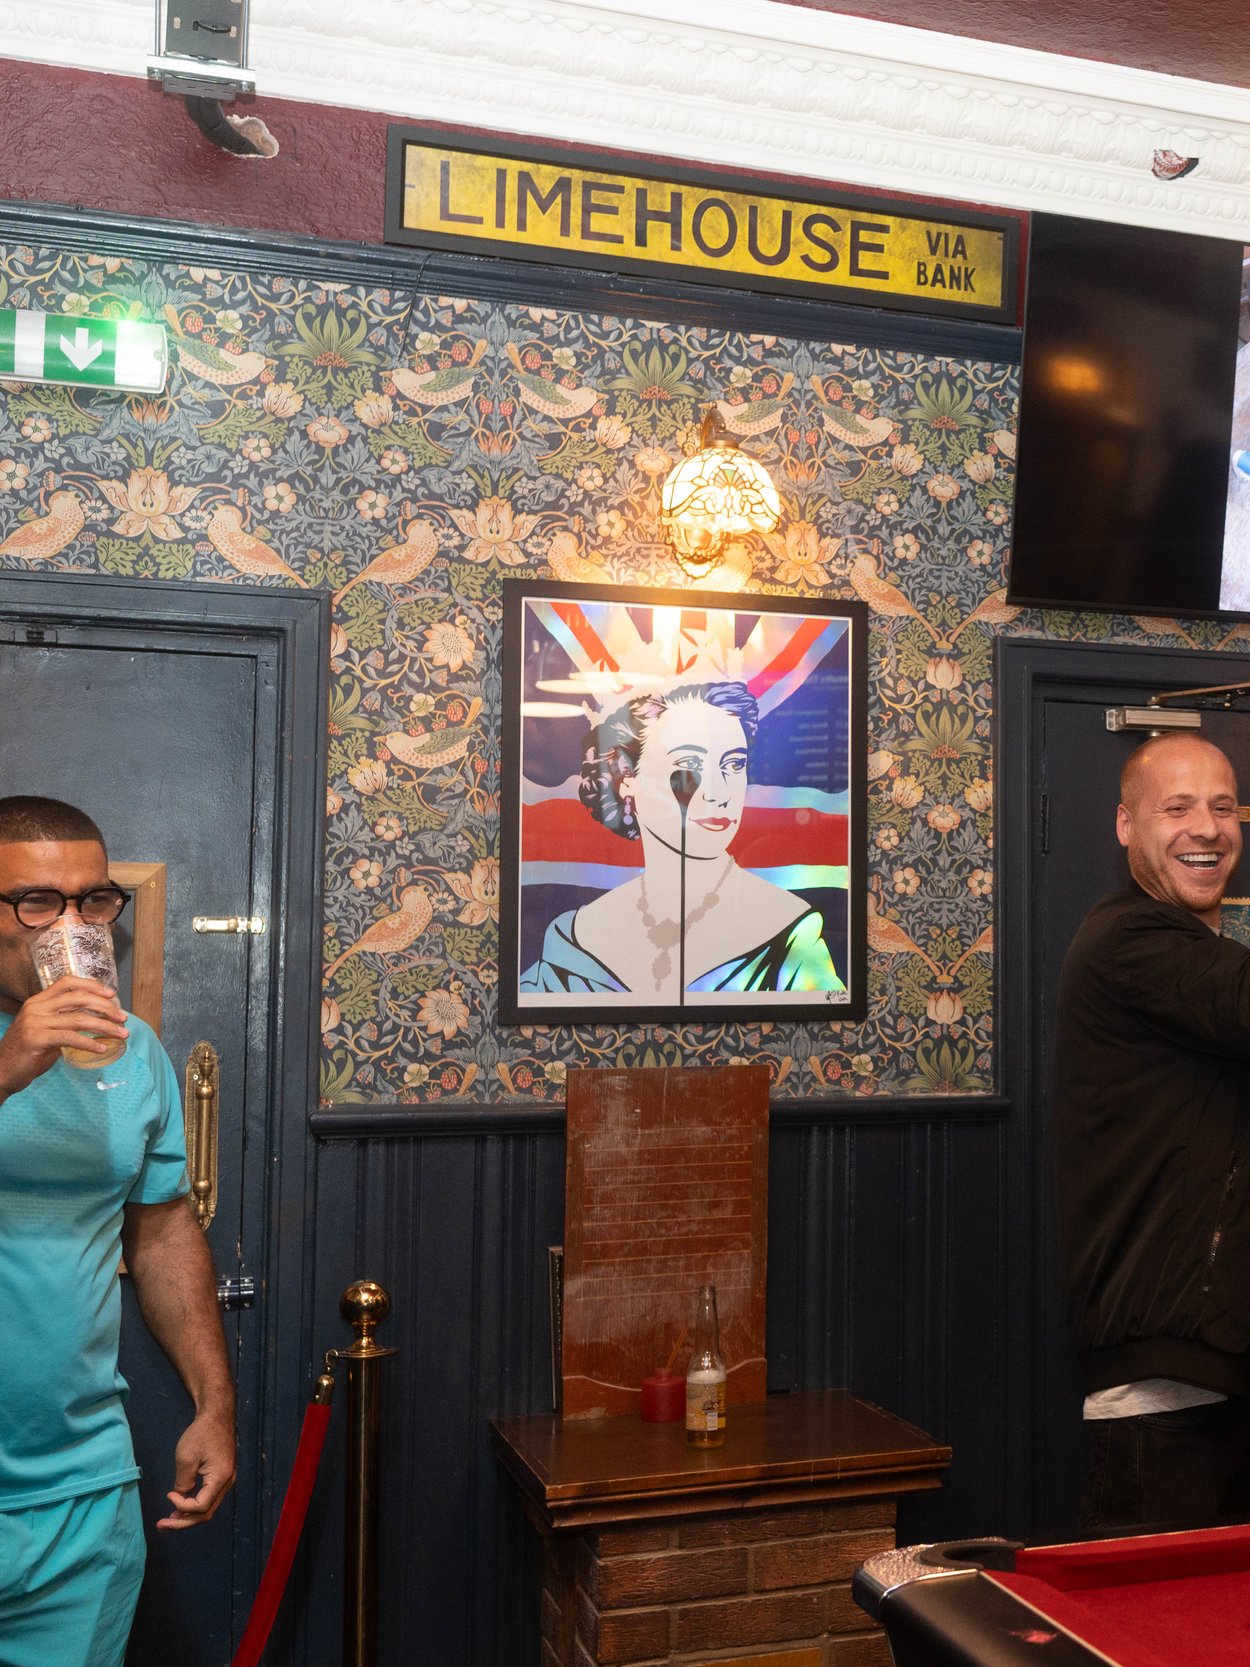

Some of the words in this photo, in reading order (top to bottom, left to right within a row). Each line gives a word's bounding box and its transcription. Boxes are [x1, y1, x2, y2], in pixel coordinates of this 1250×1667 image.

[438, 159, 892, 281] LIMEHOUSE
[925, 229, 968, 261] VIA
[916, 261, 976, 293] BANK
